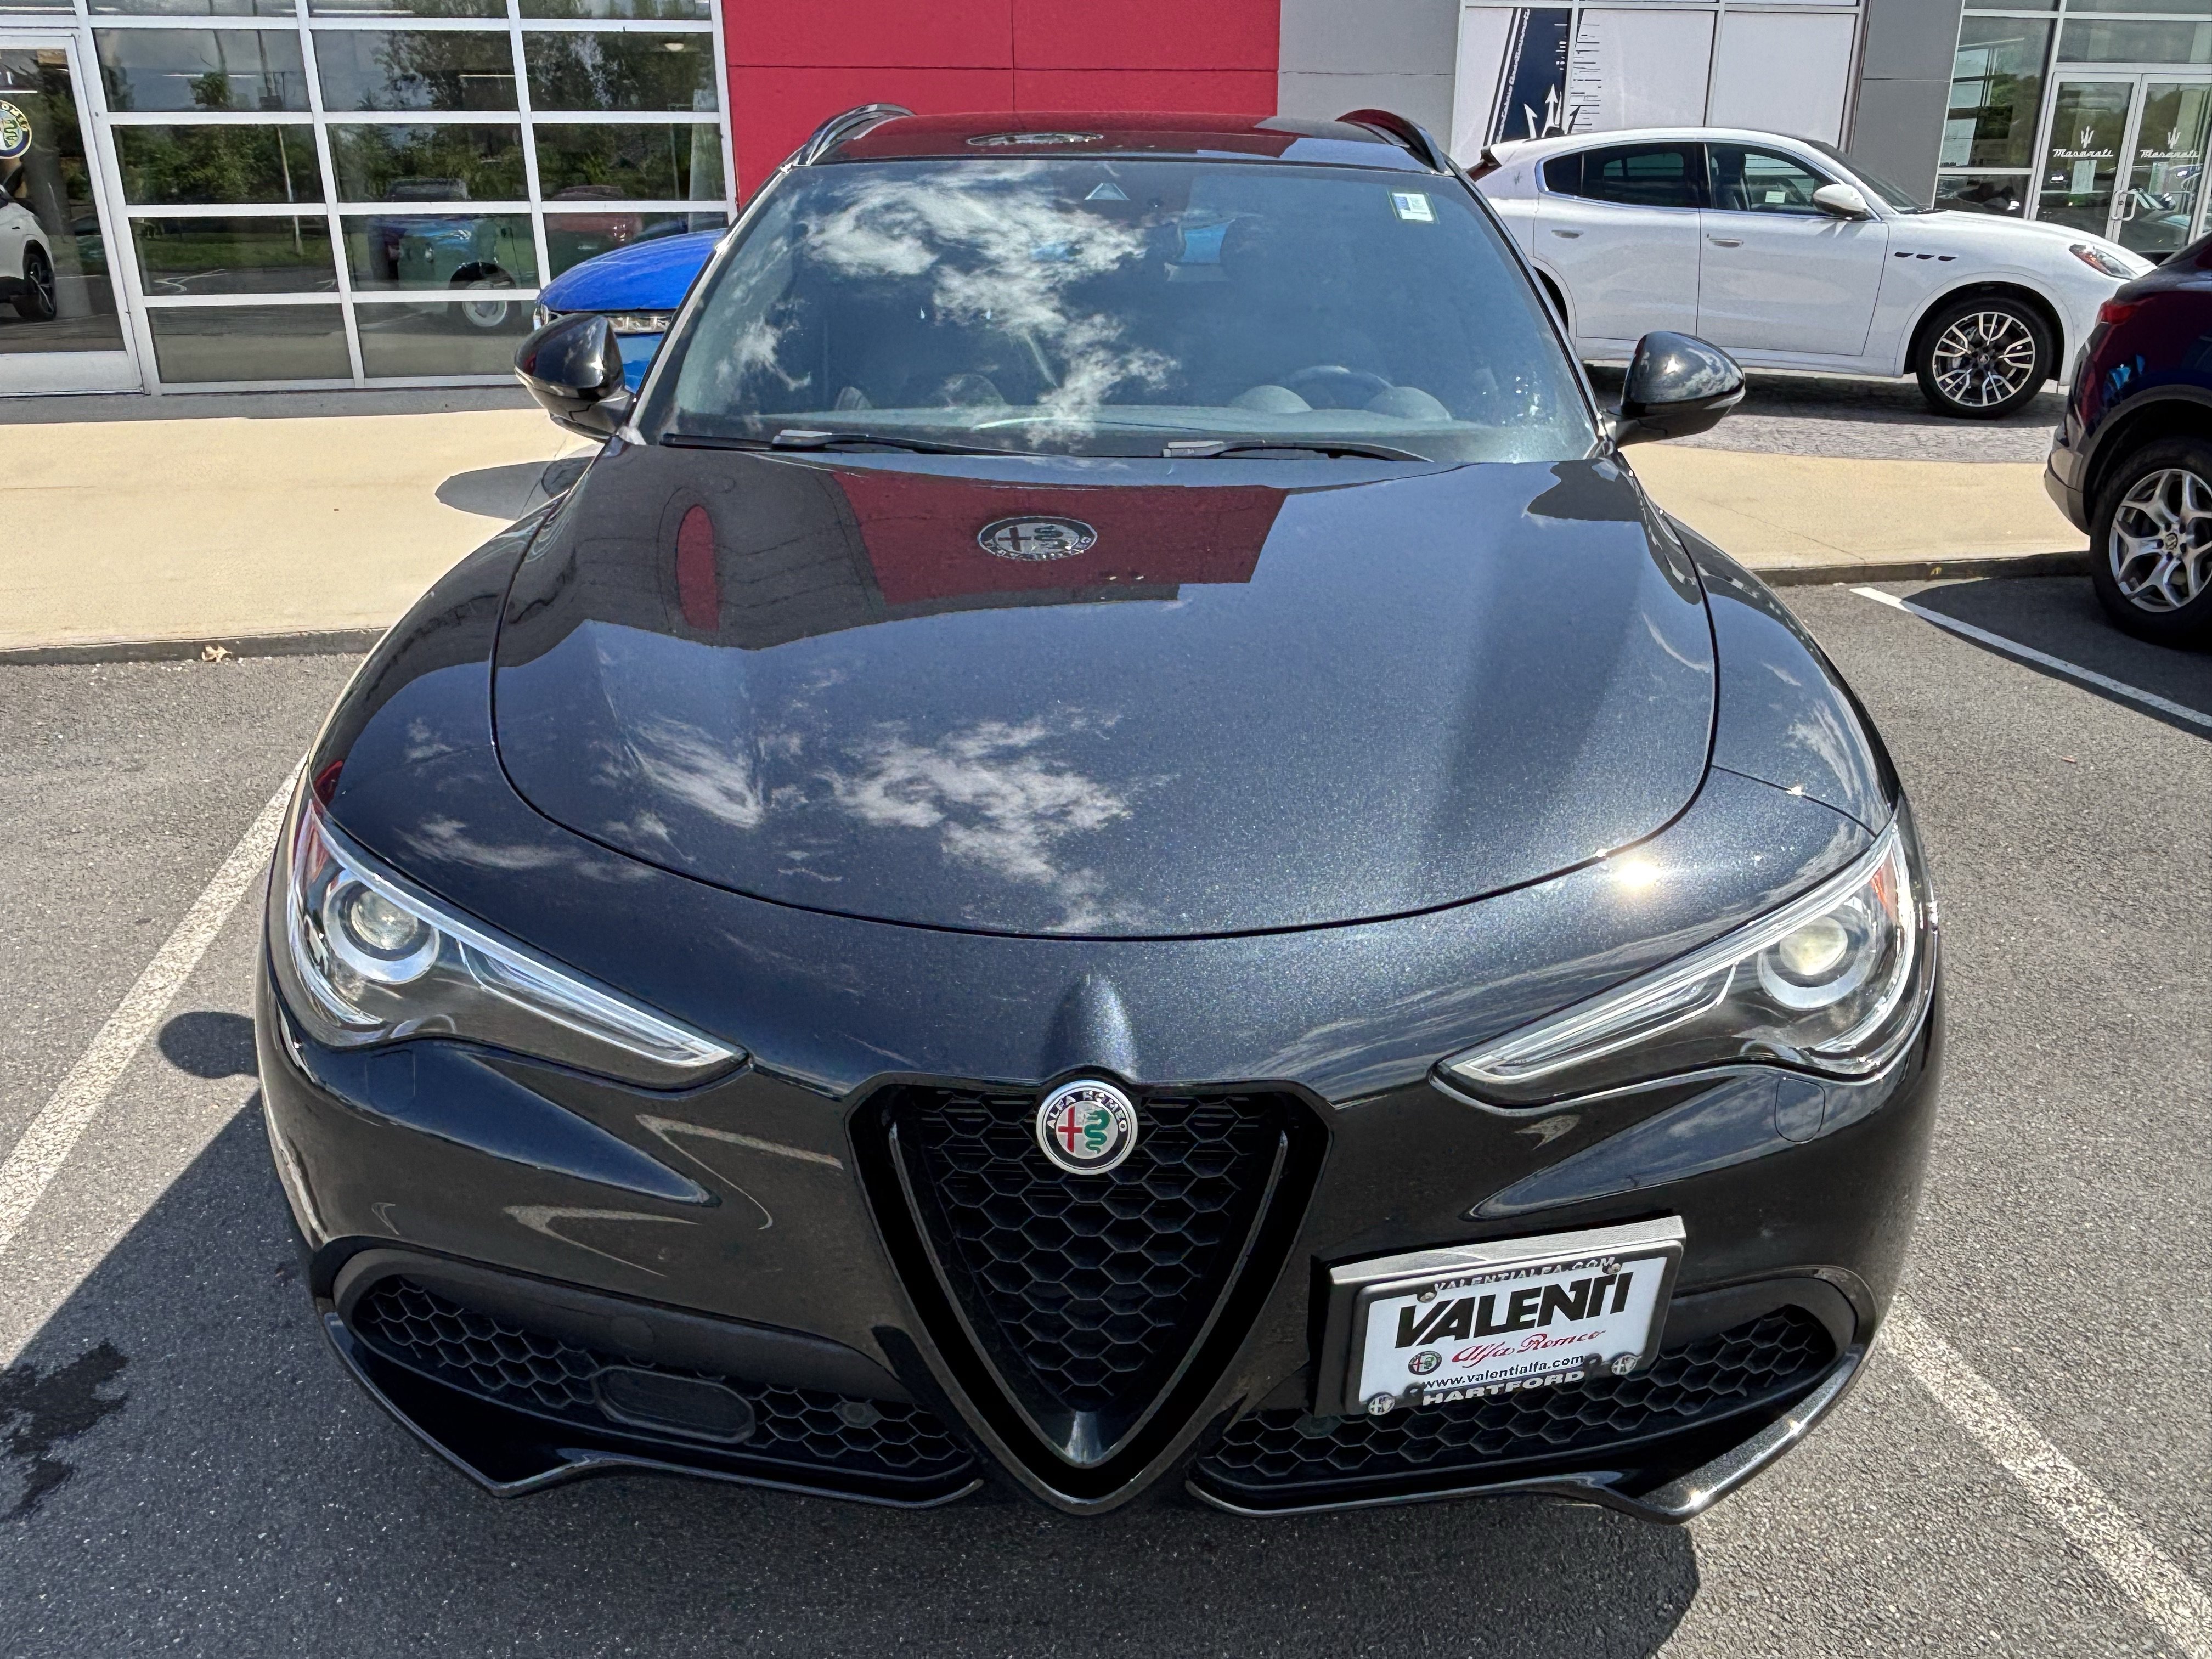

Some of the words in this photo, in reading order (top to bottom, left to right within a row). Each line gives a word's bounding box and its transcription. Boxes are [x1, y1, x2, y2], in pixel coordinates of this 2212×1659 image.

[1, 103, 29, 132] OMEO
[2052, 148, 2114, 157] Maserati
[1047, 1095, 1076, 1130] ALFA
[1395, 1272, 1634, 1349] VALENTI
[1451, 1341, 1515, 1368] Alfa
[1516, 1333, 1606, 1353] Romeo
[1421, 1355, 1584, 1389] www.valentialfa.com
[1422, 1370, 1585, 1406] HARTFORD
